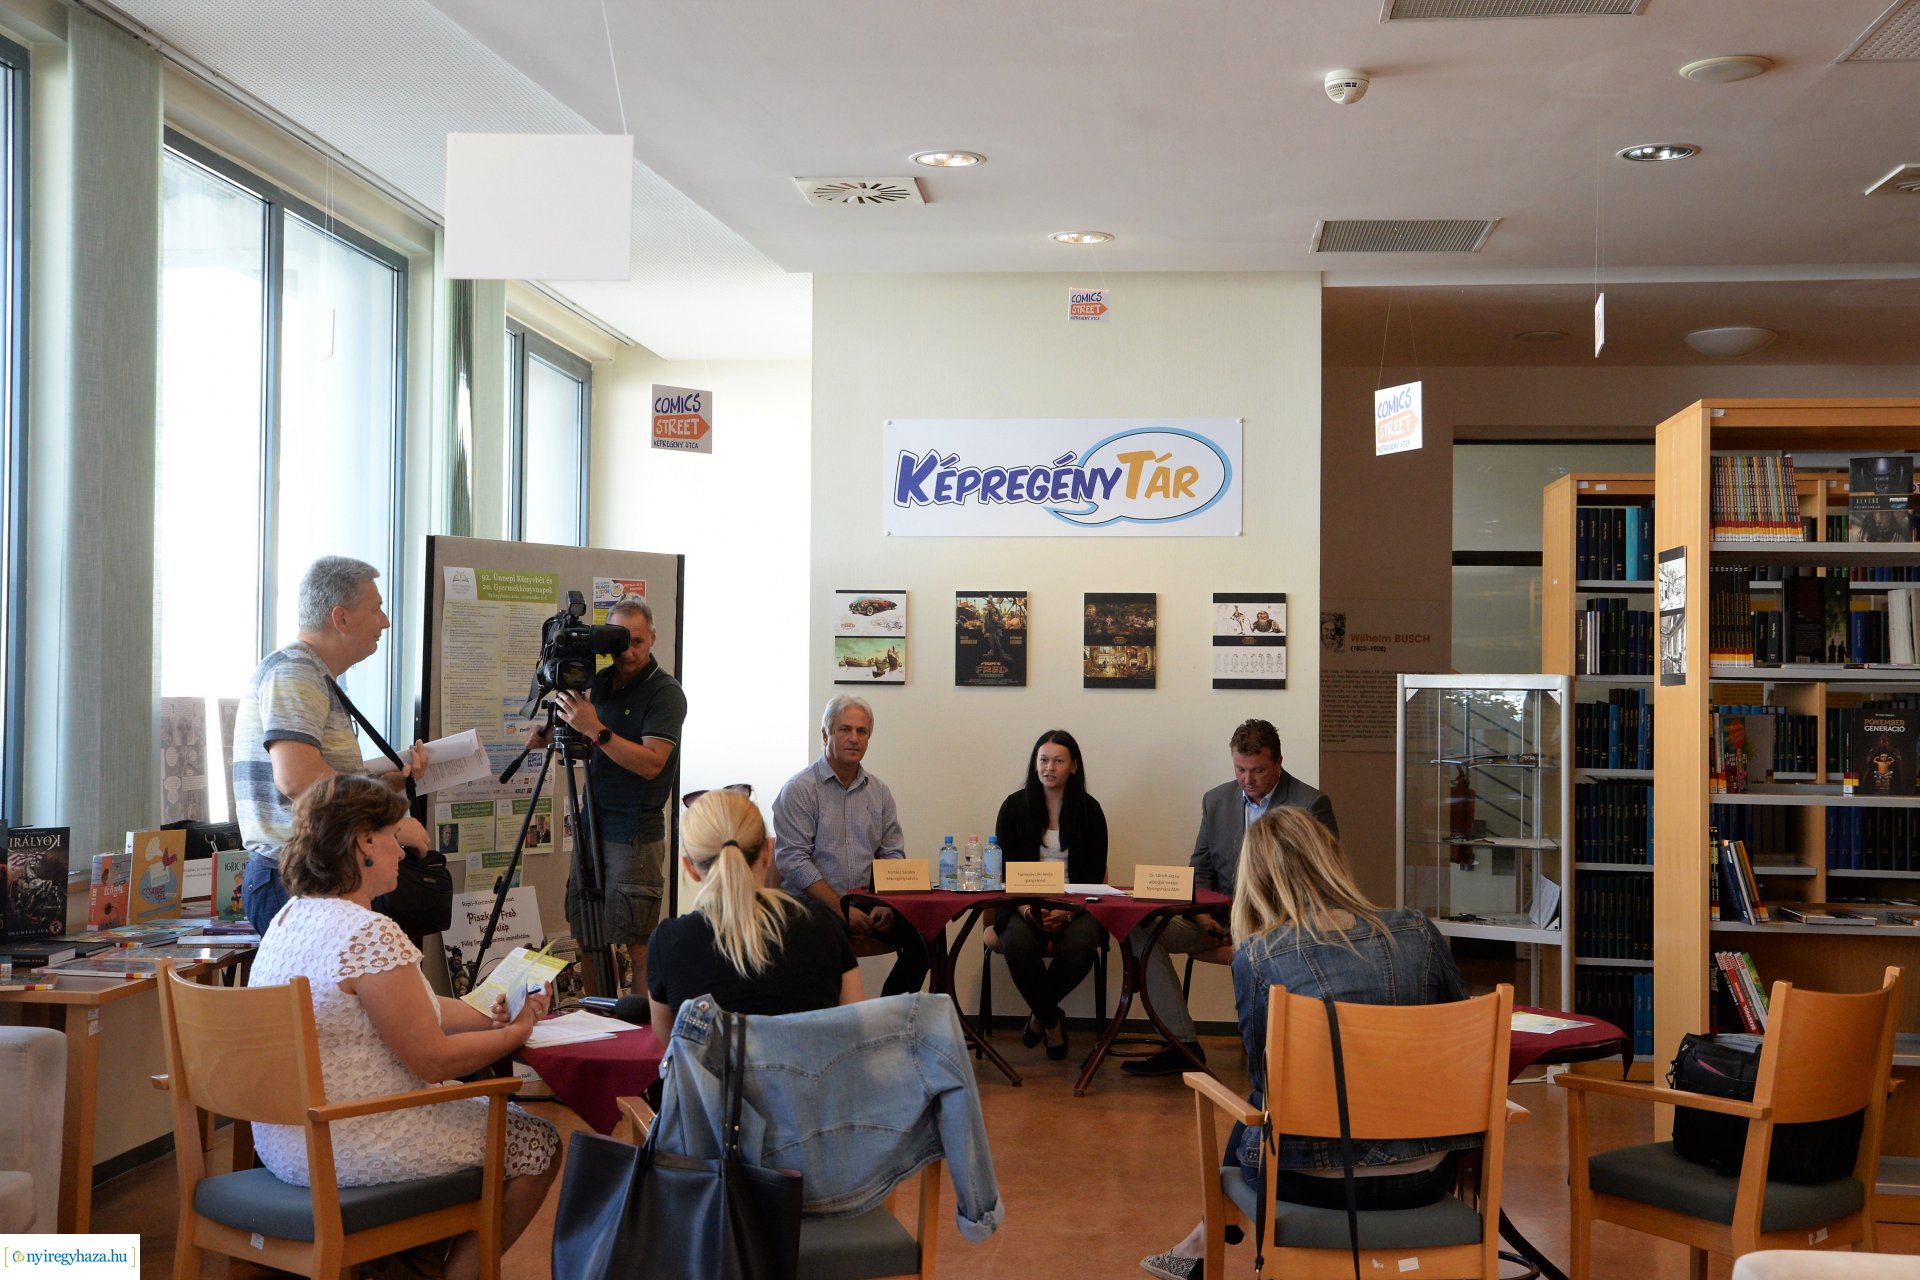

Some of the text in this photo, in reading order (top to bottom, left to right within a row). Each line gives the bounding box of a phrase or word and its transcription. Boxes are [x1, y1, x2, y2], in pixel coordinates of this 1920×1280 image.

[1072, 292, 1102, 303] COMICS
[1072, 304, 1100, 314] STREET
[654, 392, 701, 413] COMICS
[1377, 387, 1412, 418] COMICS
[656, 418, 699, 435] STREET
[1350, 634, 1430, 643] Wilhelm BUSCH
[8, 835, 61, 848] IRÁLYOK
[501, 908, 516, 920] Fred
